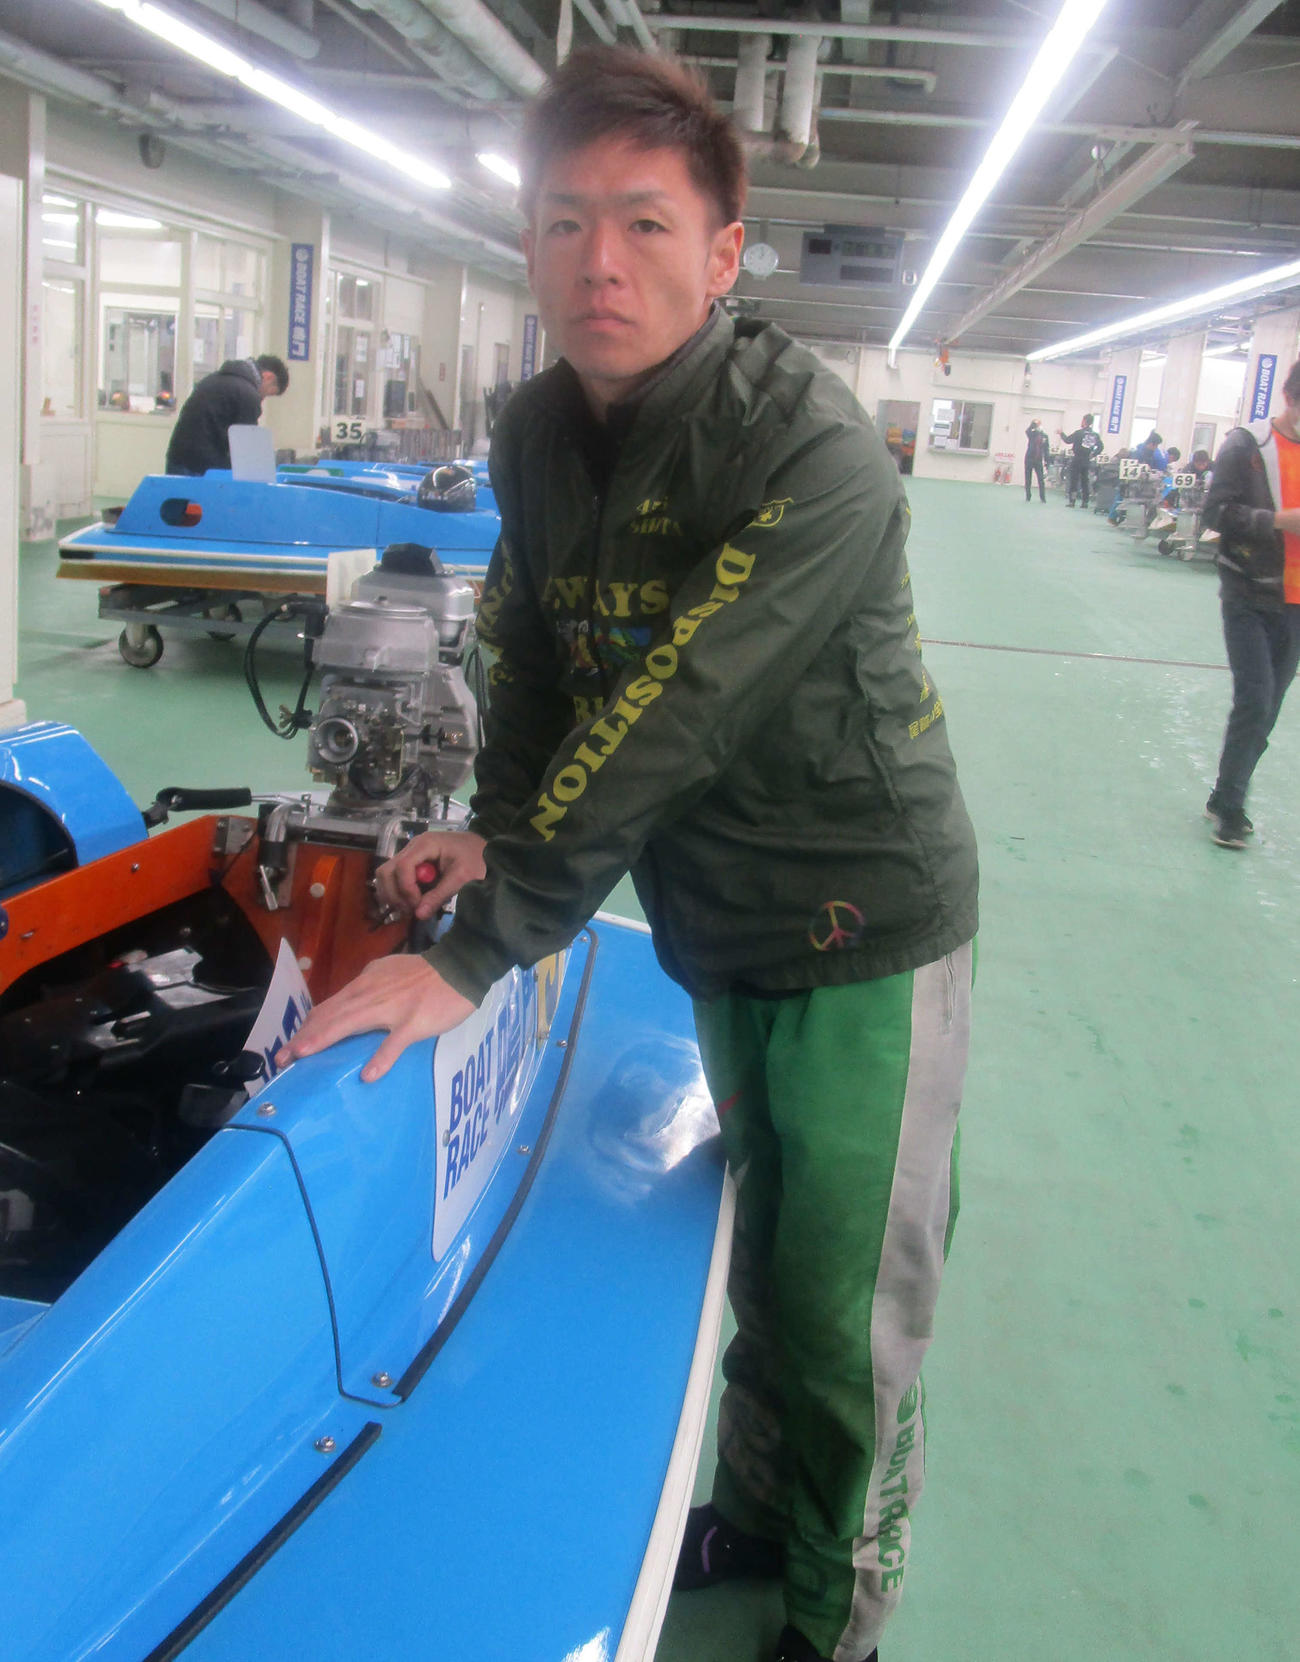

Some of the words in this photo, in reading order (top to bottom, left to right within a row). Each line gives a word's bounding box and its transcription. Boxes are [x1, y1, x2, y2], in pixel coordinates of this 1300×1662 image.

[295, 262, 308, 293] BOAT
[294, 293, 306, 324] RACE
[1258, 368, 1271, 392] BOAT
[1255, 392, 1267, 417] RACE
[336, 421, 362, 439] 35
[1174, 475, 1194, 486] 69
[529, 543, 756, 843] DISPOSITION
[450, 1026, 495, 1134] BOAT
[443, 1089, 492, 1201] RACE
[880, 1423, 915, 1497] BOAT
[878, 1499, 911, 1593] RACE
